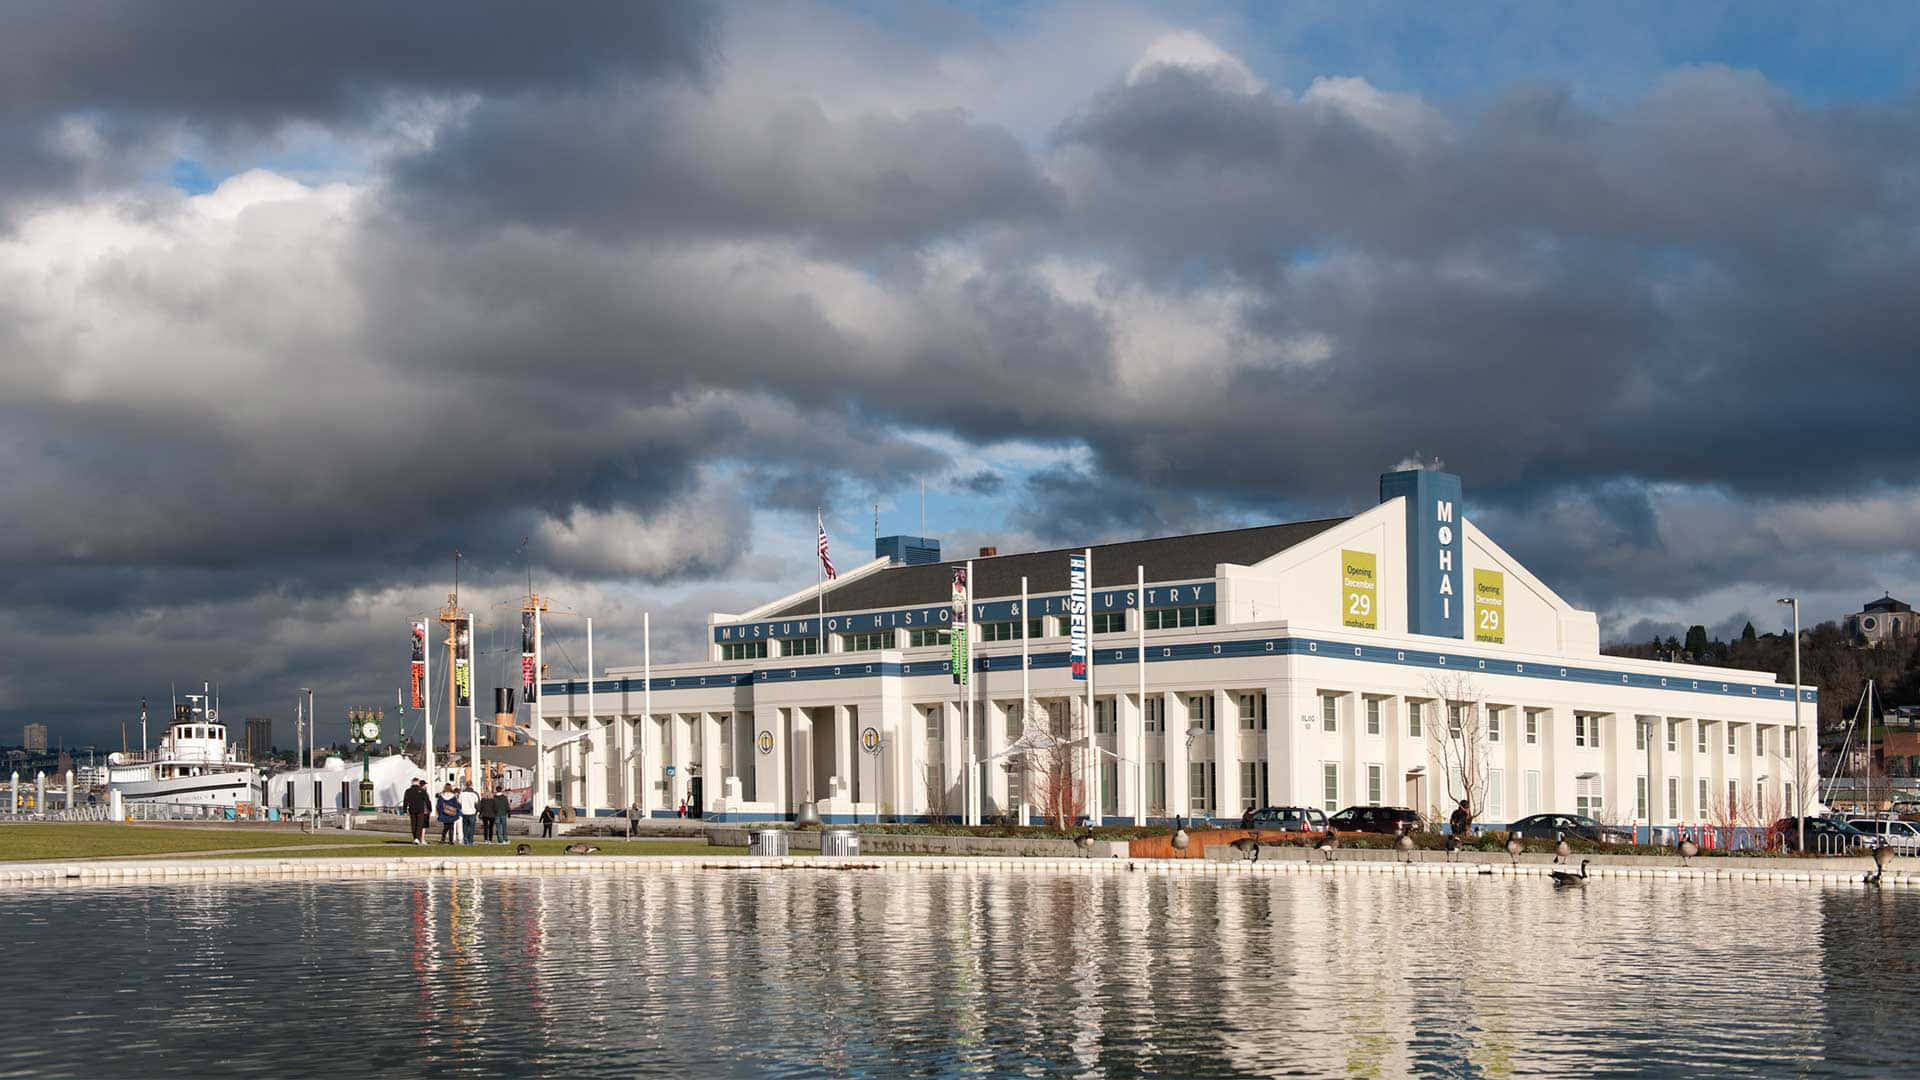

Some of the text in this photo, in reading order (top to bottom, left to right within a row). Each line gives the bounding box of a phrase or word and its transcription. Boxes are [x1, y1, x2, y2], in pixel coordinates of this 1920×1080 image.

[1437, 500, 1453, 619] MOHAI
[1347, 565, 1373, 578] Opening
[1478, 583, 1500, 595] Opening
[722, 587, 1202, 640] MUSEUM OF HISTOY & INUSTRY
[1071, 570, 1087, 657] MUSEUM
[1349, 593, 1370, 616] 29
[1480, 608, 1499, 630] 29
[1072, 661, 1087, 675] OF
